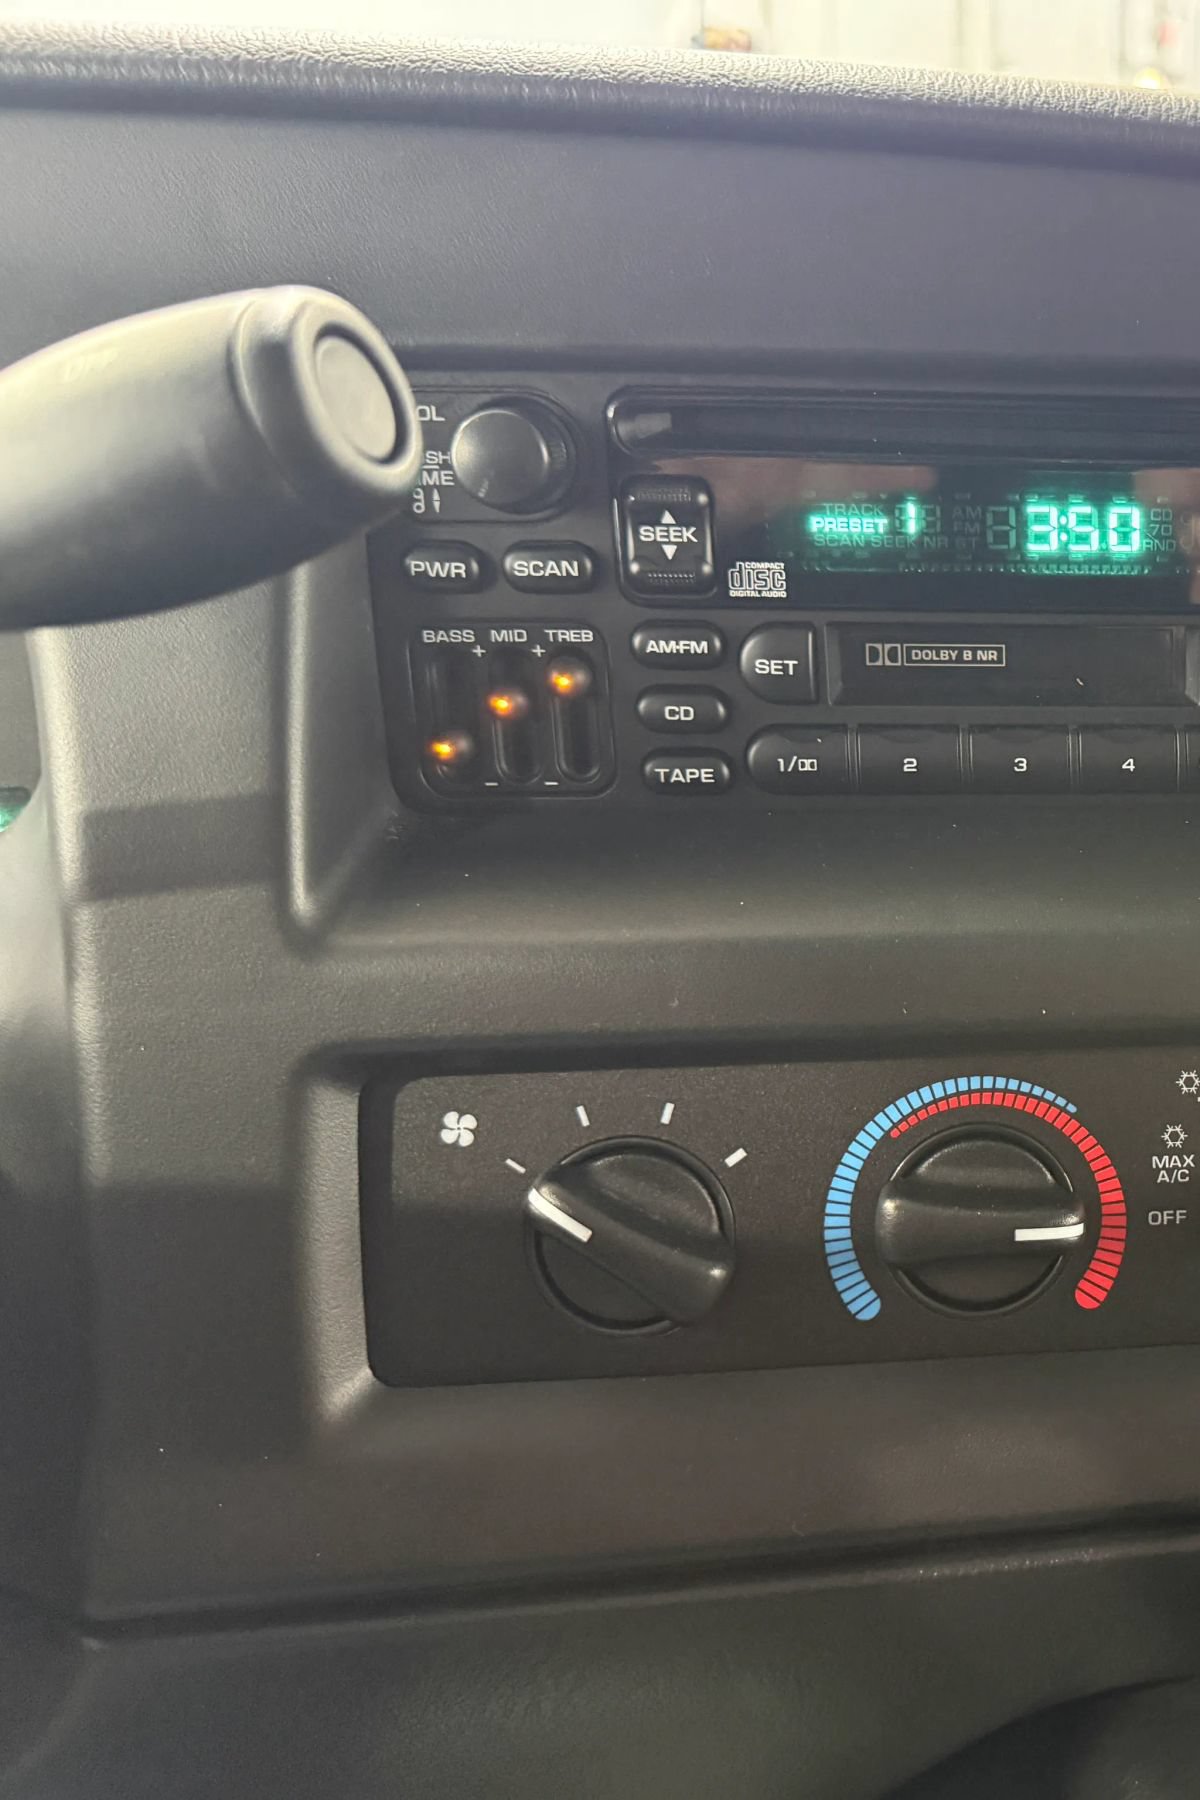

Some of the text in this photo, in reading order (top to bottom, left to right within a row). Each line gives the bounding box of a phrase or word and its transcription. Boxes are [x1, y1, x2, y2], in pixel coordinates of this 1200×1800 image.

[416, 405, 445, 422] OL
[421, 471, 455, 486] ME
[823, 503, 884, 517] TRACK
[1150, 508, 1172, 521] CD
[811, 517, 888, 533] PRESET
[1026, 505, 1141, 552] 3:50
[639, 526, 698, 543] SEEK
[814, 534, 865, 547] SCAN
[410, 560, 467, 578] PWR
[513, 560, 580, 577] SCAN
[745, 561, 785, 569] COMPACT
[729, 590, 787, 598] DIGITAL AUDIO
[422, 630, 475, 643] BASS
[491, 630, 527, 643] MID
[544, 630, 594, 643] TREB
[911, 650, 998, 661] DOLBY B NR
[755, 659, 798, 675] SET
[664, 706, 695, 721] CD
[903, 758, 917, 772] 2
[1013, 757, 1027, 772] 3
[1121, 758, 1135, 772] 4
[655, 768, 715, 783] TAPE
[1152, 1155, 1195, 1168] MAX
[1157, 1169, 1190, 1183] A/C
[1148, 1210, 1187, 1225] OFF
